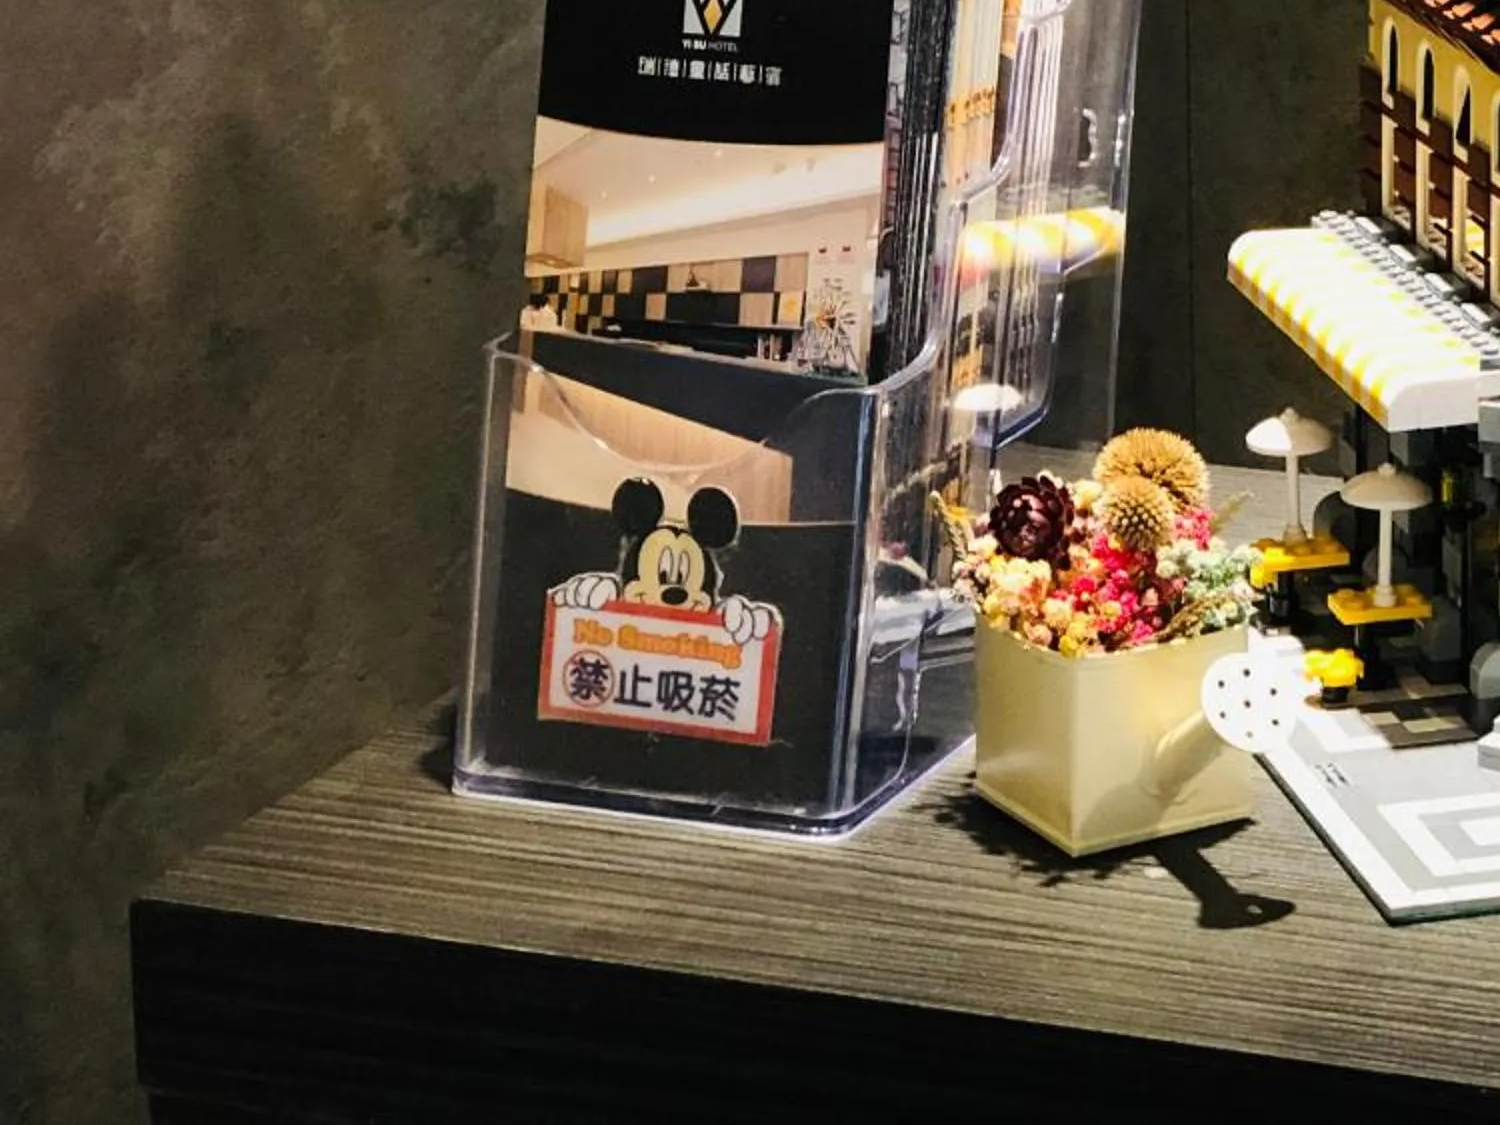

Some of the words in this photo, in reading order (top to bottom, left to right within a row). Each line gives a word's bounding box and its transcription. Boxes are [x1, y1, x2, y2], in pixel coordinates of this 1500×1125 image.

[573, 617, 614, 646] No
[617, 624, 743, 671] Smoking
[569, 655, 742, 722] 禁止吸菸
